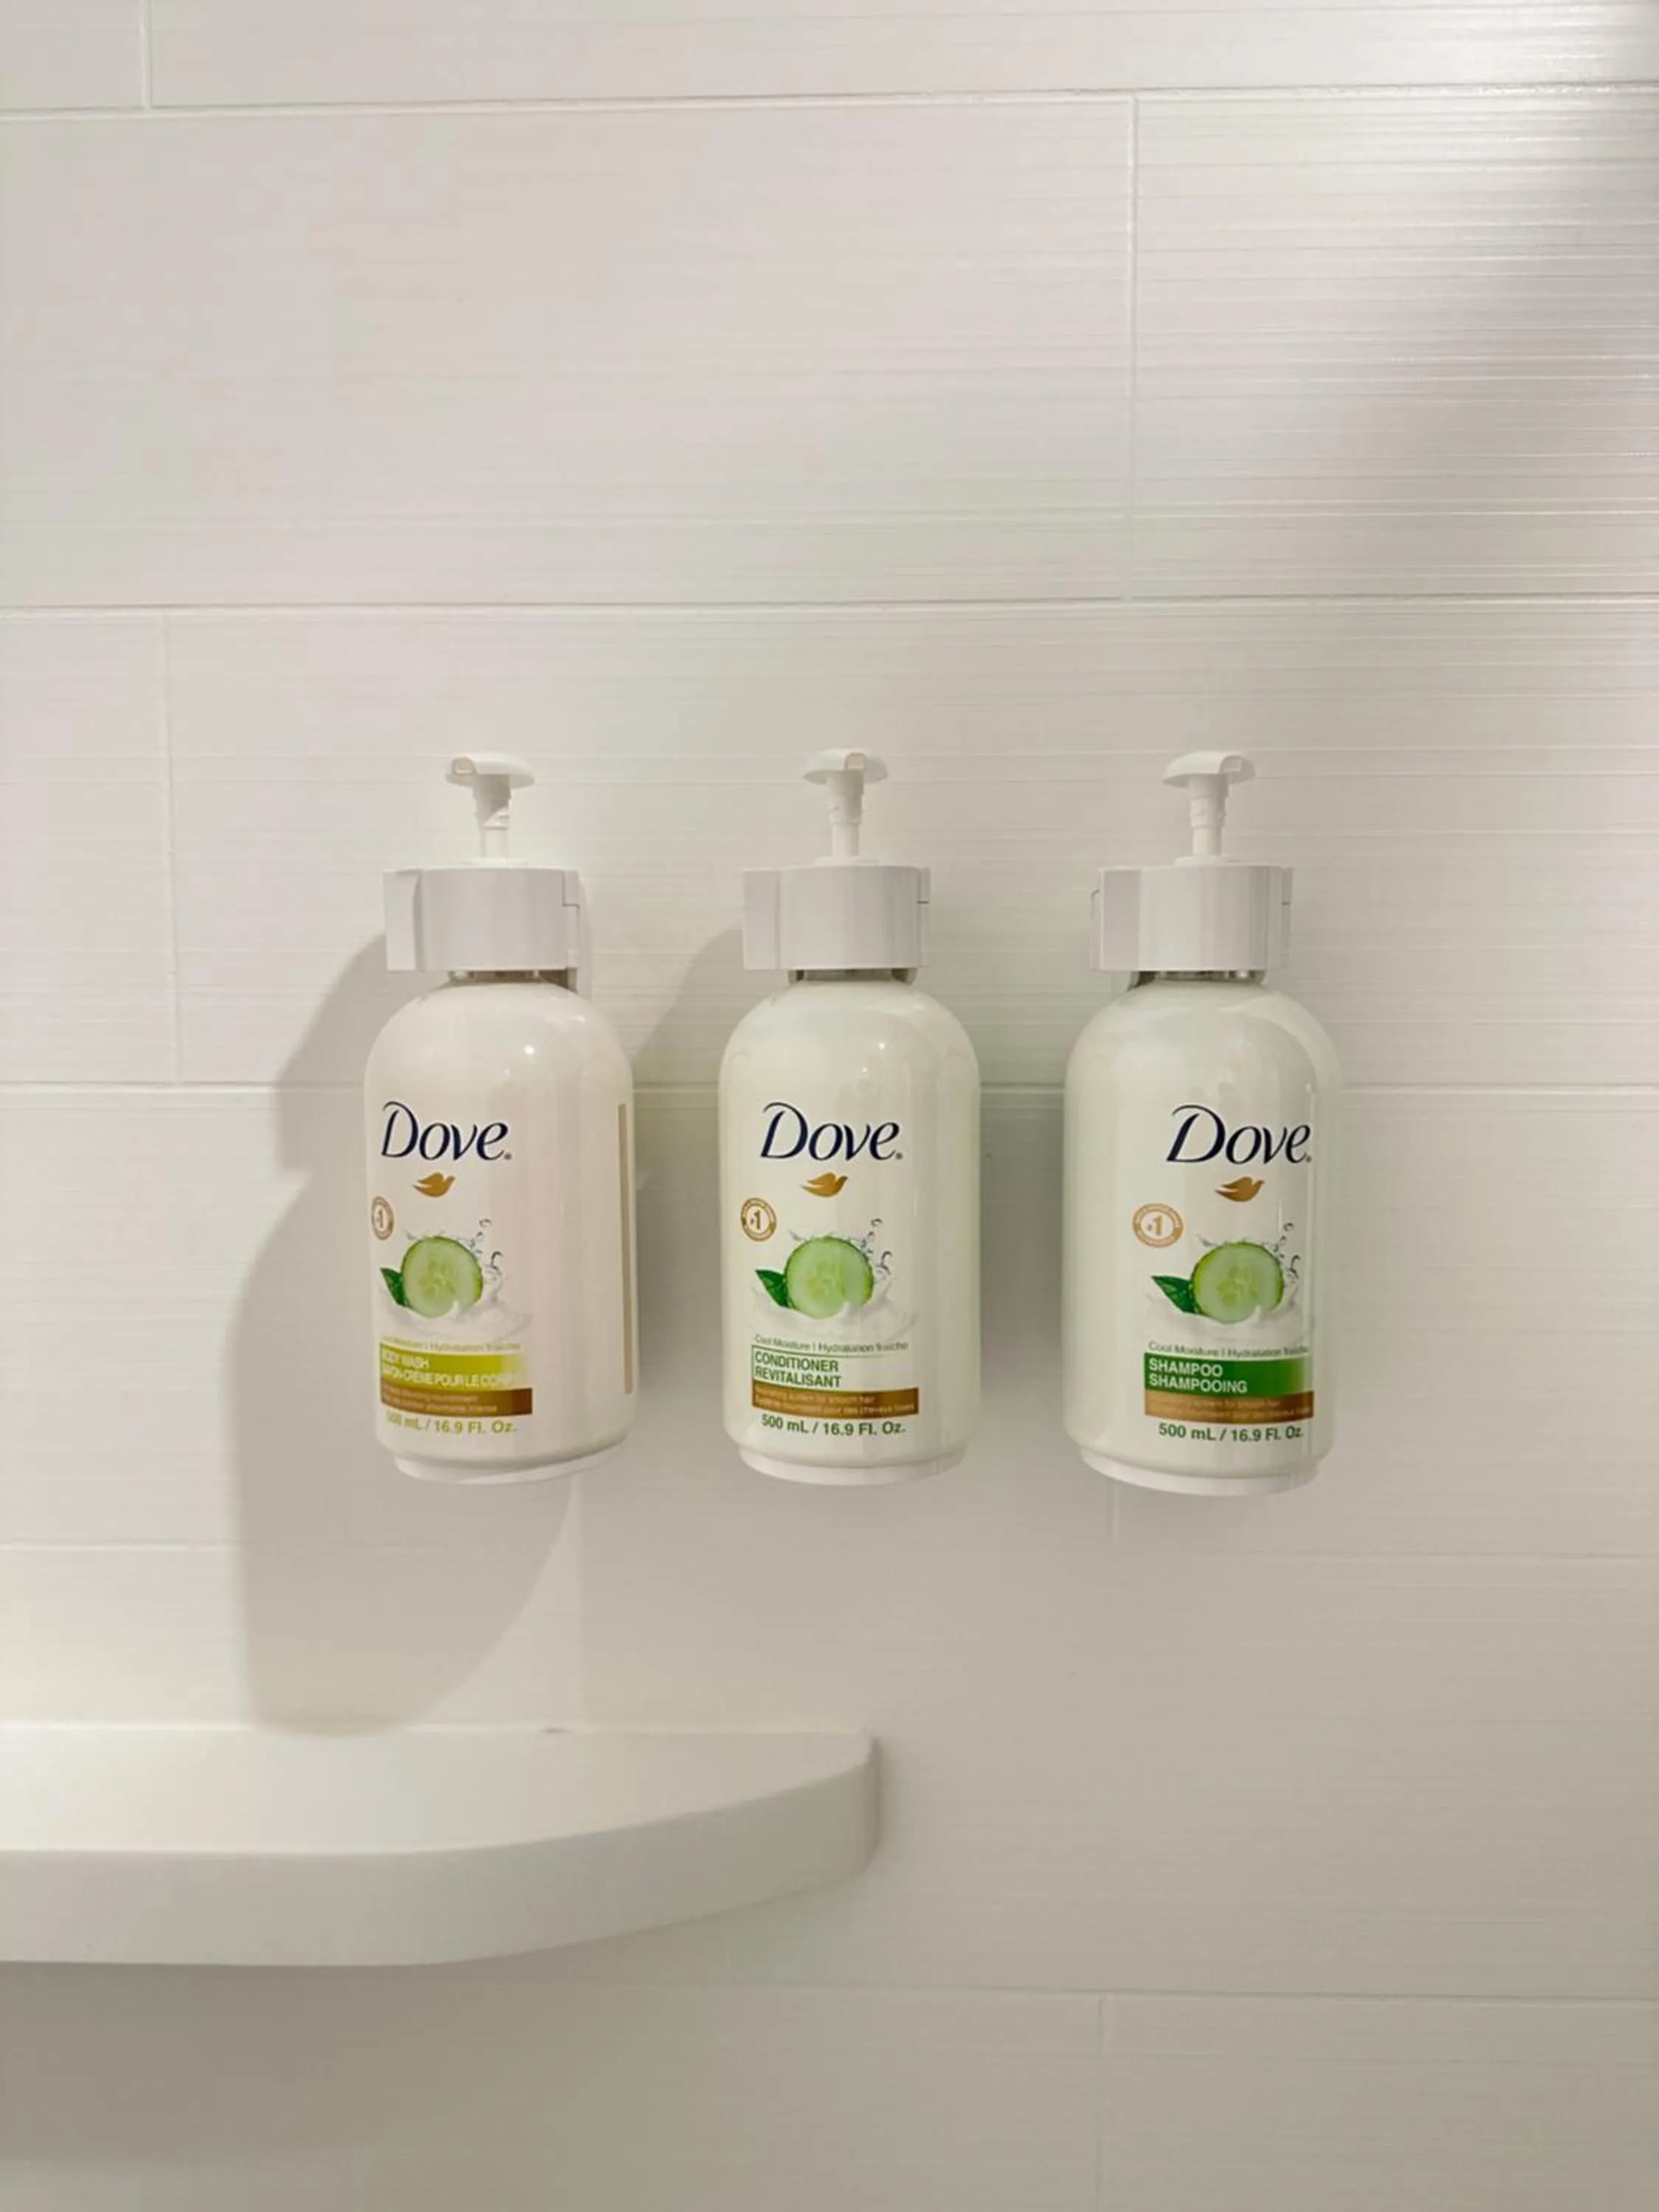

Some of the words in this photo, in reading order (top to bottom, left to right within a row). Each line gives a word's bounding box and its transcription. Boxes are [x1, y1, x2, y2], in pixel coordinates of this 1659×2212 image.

[380, 1101, 509, 1161] Dove
[760, 1102, 900, 1161] Dove
[1166, 1105, 1310, 1164] Dove
[755, 1350, 838, 1372] CONDITIONER
[1149, 1357, 1224, 1377] SHAMPOO
[755, 1366, 841, 1388] REVITALISANT
[1149, 1372, 1248, 1394] SHAMPOOING
[434, 1420, 463, 1433] 16.9
[762, 1413, 784, 1430] 500
[787, 1419, 810, 1434] mL
[823, 1422, 854, 1436] 16.9
[858, 1422, 877, 1436] Fl.
[882, 1420, 906, 1435] Oz.
[1158, 1422, 1186, 1439] 500
[1191, 1426, 1216, 1441] mL
[1231, 1428, 1262, 1442] 16.9
[1265, 1428, 1281, 1441] Fl.
